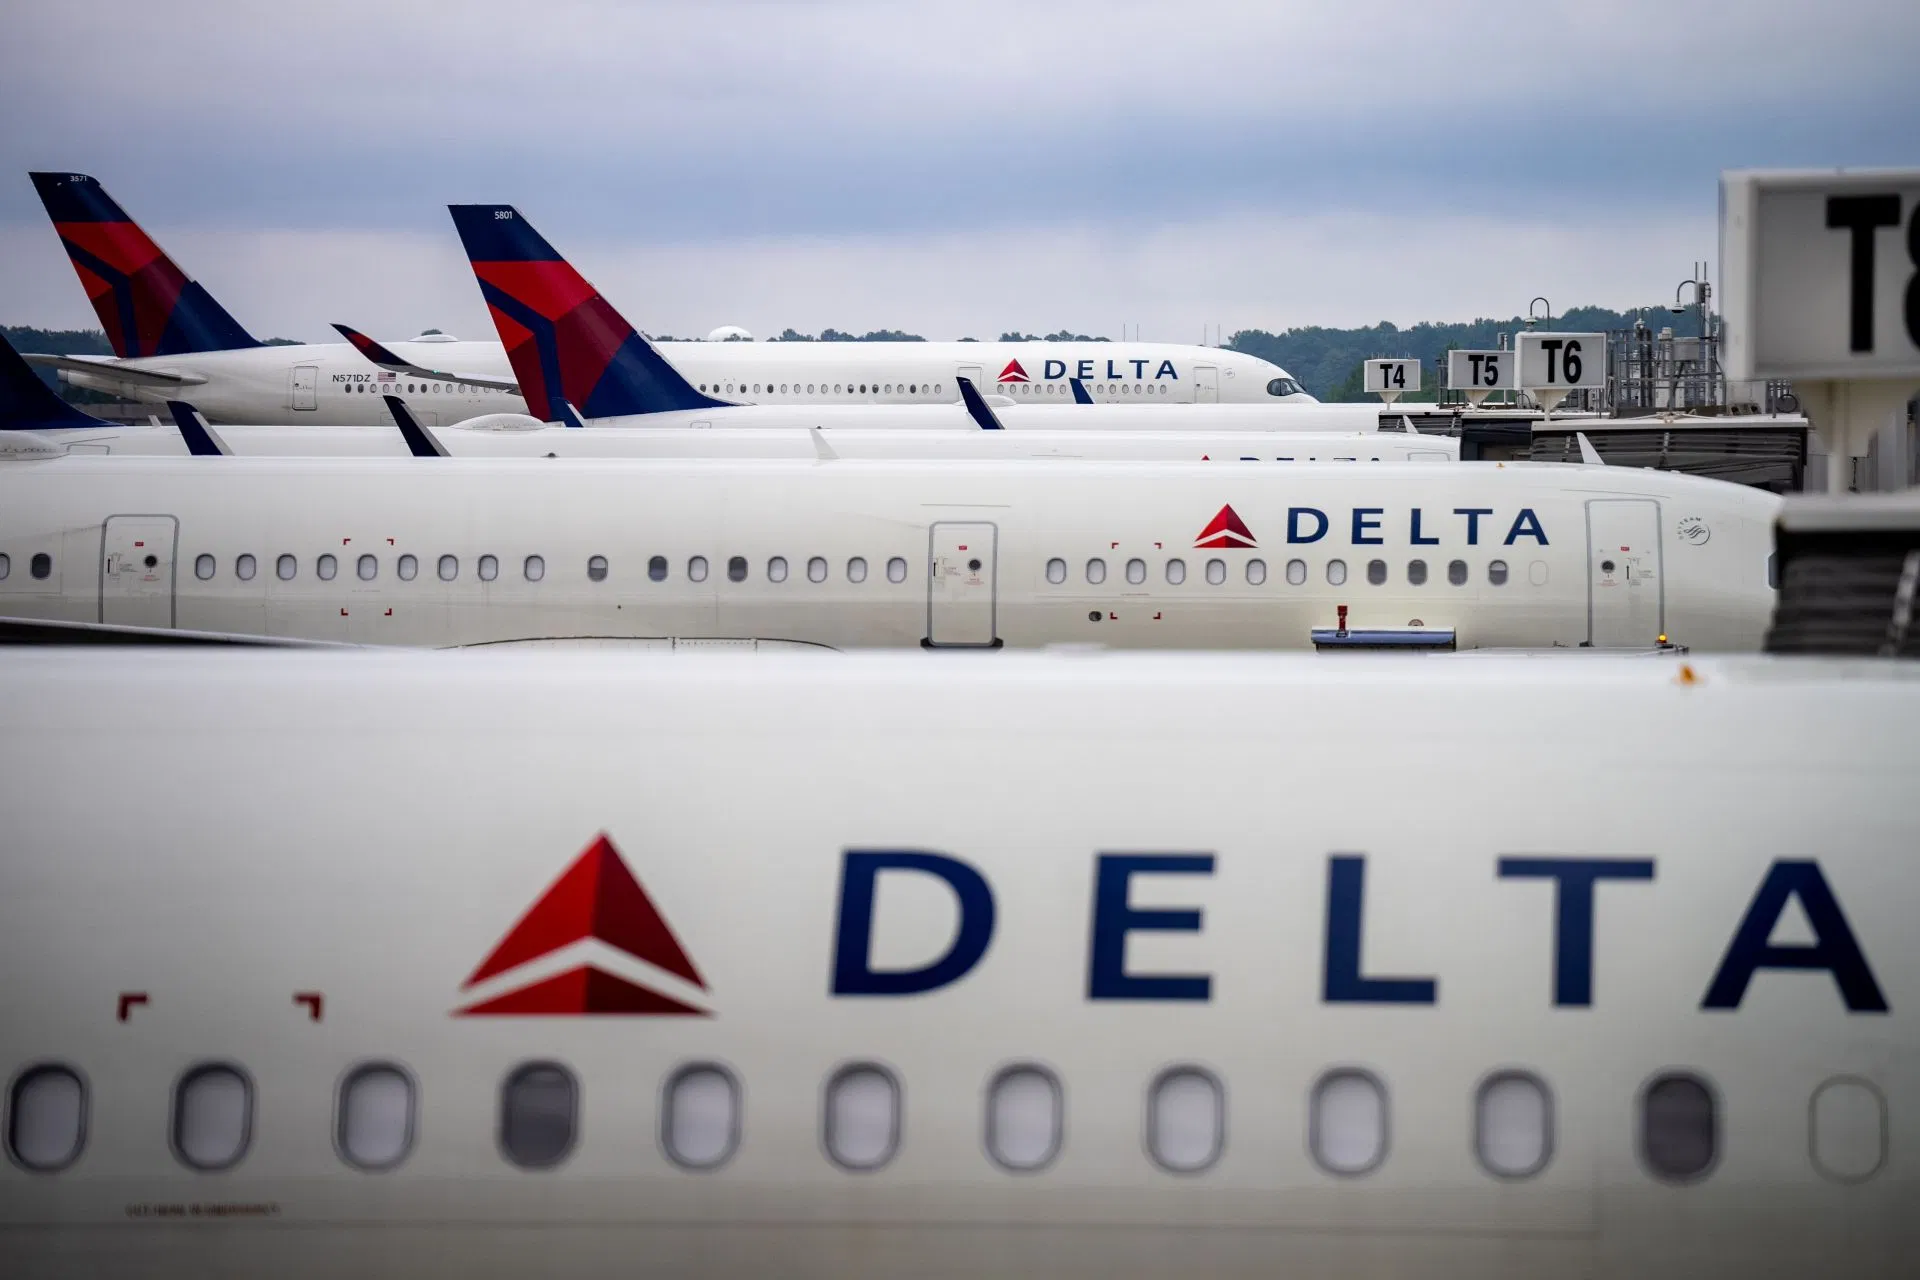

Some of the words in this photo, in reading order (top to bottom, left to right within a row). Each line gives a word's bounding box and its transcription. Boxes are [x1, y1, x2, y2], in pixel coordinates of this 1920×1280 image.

[494, 211, 513, 220] 5801
[1826, 194, 1920, 354] T
[1044, 359, 1179, 380] DELTA
[1380, 363, 1405, 389] T4
[1468, 354, 1499, 386] T5
[1541, 339, 1582, 384] T6
[332, 374, 371, 383] N571DZ
[1287, 507, 1549, 545] DELTA
[830, 848, 1890, 1013] DELTA
